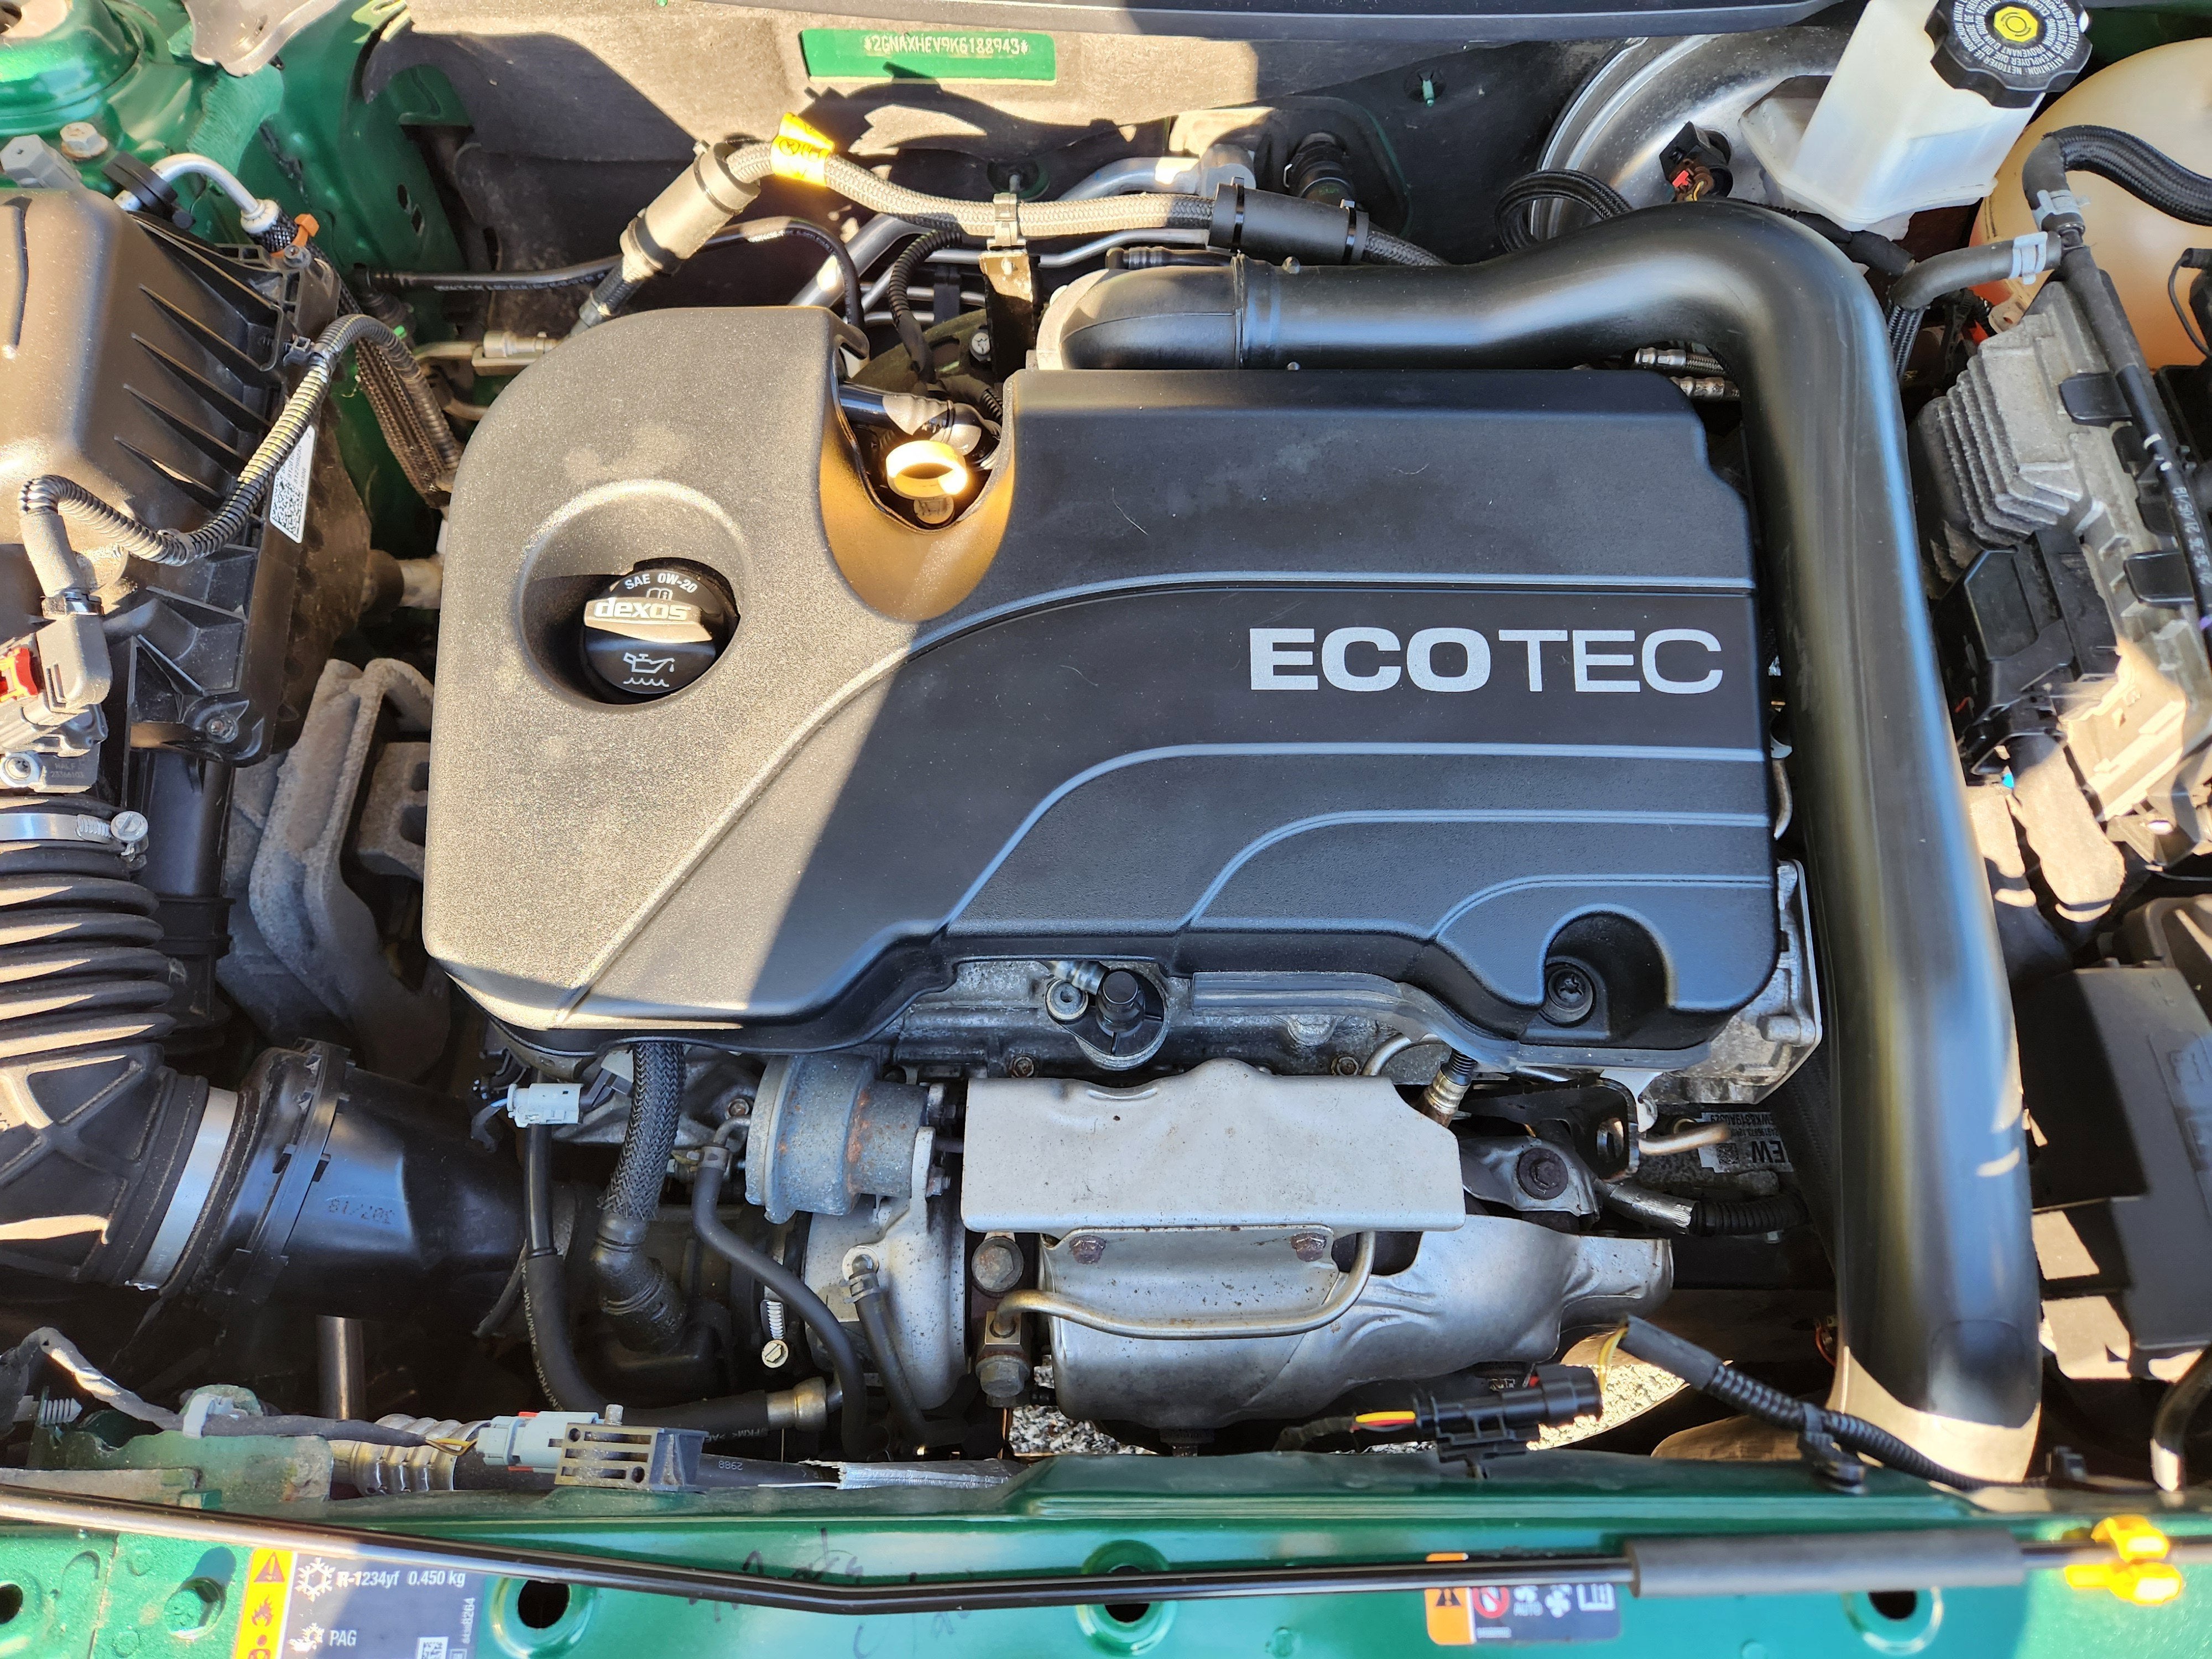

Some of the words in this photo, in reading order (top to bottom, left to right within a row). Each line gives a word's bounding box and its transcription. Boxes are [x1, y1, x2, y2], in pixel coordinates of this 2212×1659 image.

[1953, 2, 1965, 22] AVANT
[1964, 14, 1974, 22] DE
[2062, 8, 2078, 26] FROM
[1954, 22, 1977, 52] BOUCHON
[1965, 24, 1985, 47] LIQUIDE
[2057, 19, 2068, 43] BEFORE
[2068, 26, 2079, 45] FLUID
[1974, 50, 1985, 60] LE
[1981, 45, 1994, 55] DU
[2001, 44, 2046, 58] PROVENANT
[2051, 41, 2064, 54] CAP
[1983, 56, 2022, 75] NETTOYER
[1994, 51, 2009, 64] QUE
[624, 573, 651, 590] SAE
[657, 572, 698, 593] 0W-20
[594, 597, 687, 620] dexos
[1249, 627, 1724, 694] ECOTEC
[1751, 1140, 1786, 1163] EW
[718, 1460, 743, 1471] 2988
[336, 1571, 399, 1588] R-1234yf
[408, 1570, 444, 1587] 0.450
[446, 1571, 466, 1588] kg
[329, 1630, 357, 1646] PAG
